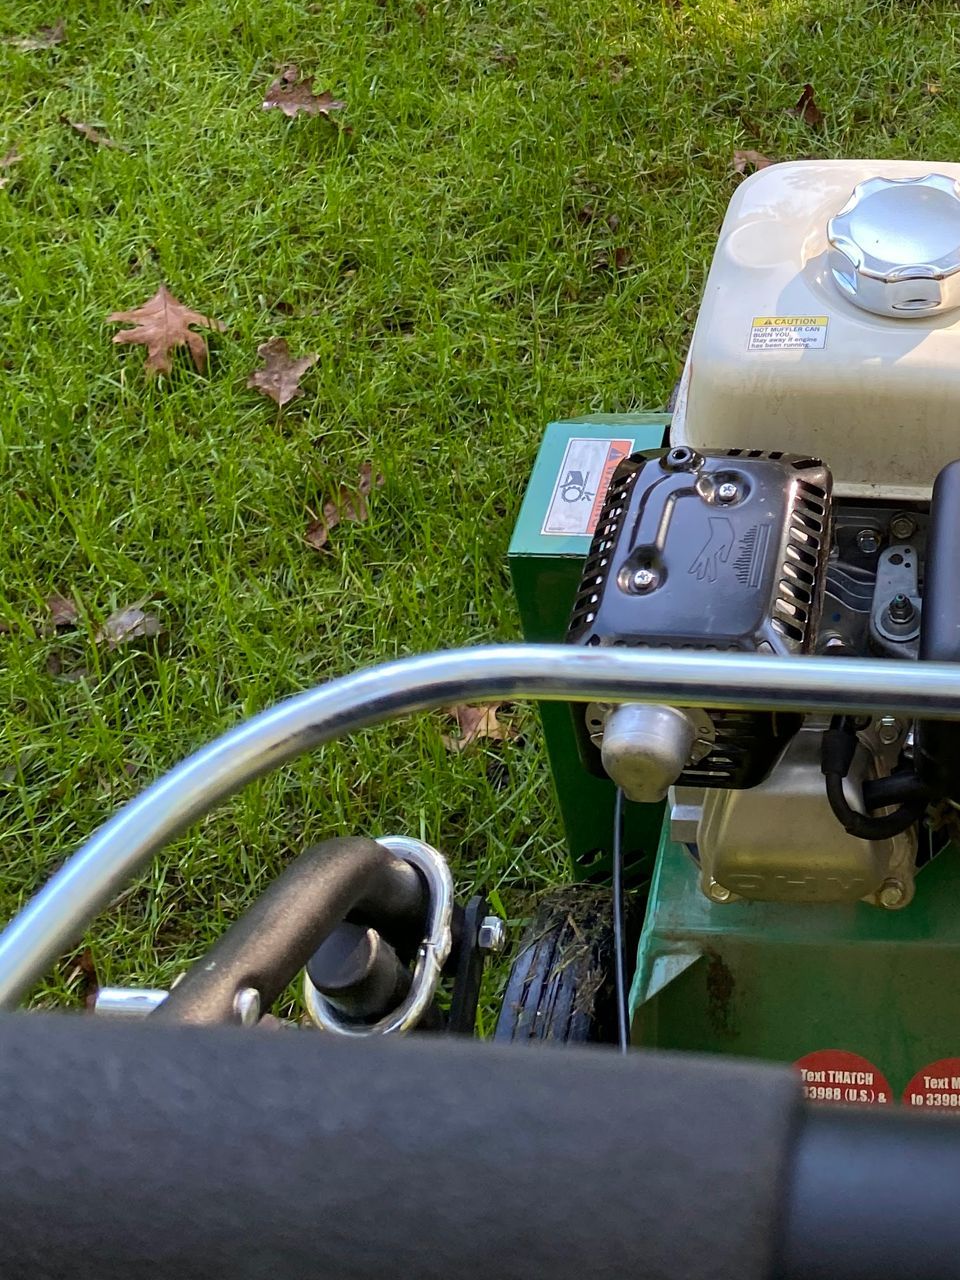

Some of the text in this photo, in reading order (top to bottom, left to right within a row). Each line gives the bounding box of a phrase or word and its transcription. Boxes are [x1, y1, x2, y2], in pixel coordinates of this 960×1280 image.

[801, 1069, 873, 1085] Text THATCH
[924, 1076, 949, 1089] Text
[844, 1088, 875, 1103] (U.S.)
[878, 1092, 886, 1103] &
[911, 1093, 923, 1106] to
